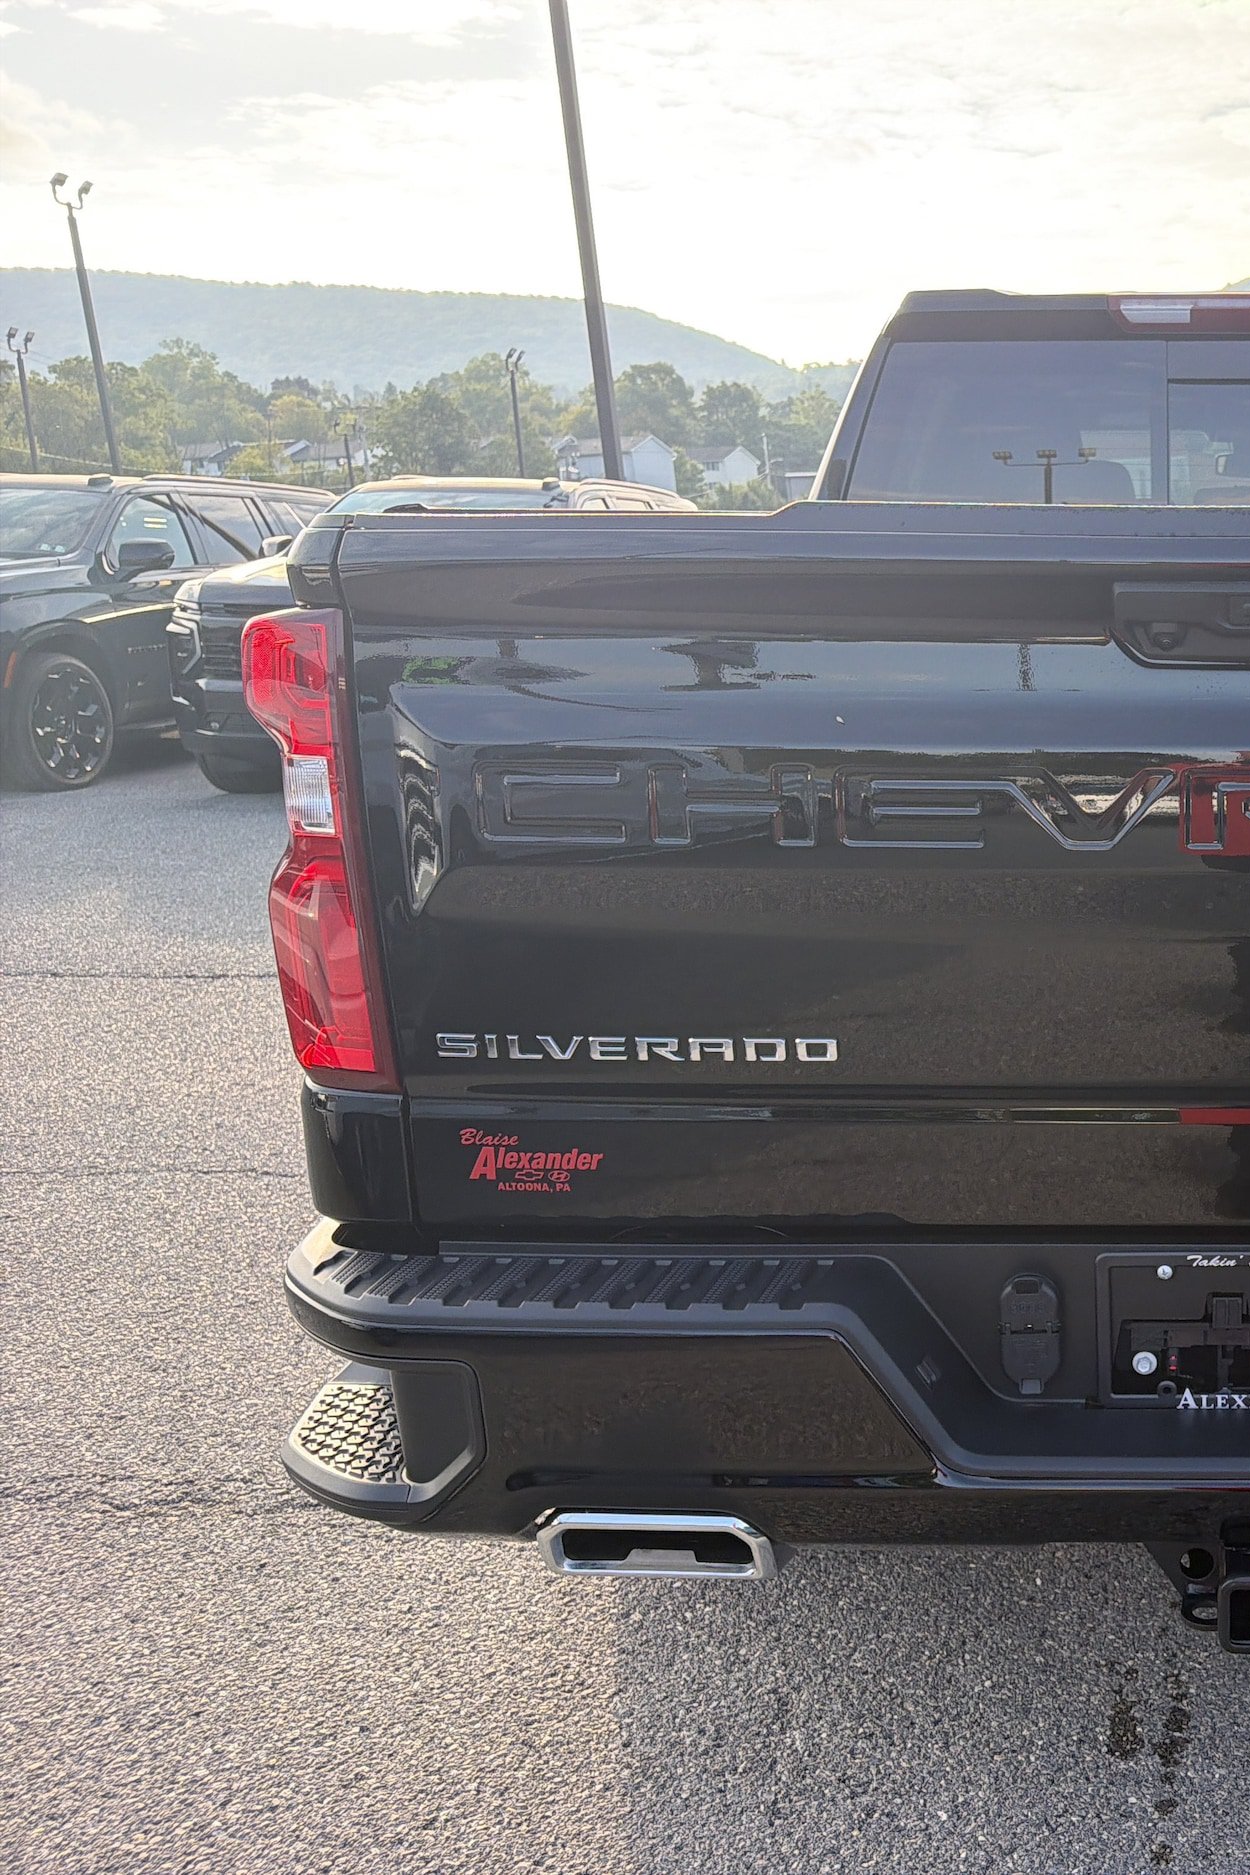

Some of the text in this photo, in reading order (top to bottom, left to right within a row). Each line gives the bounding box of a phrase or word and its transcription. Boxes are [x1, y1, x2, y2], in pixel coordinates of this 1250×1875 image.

[435, 1032, 838, 1063] SILVERADO
[459, 1127, 519, 1146] Blaise
[469, 1146, 604, 1180] Alexander
[497, 1182, 571, 1193] ALTOONA, PA
[1186, 1254, 1244, 1267] Takin'
